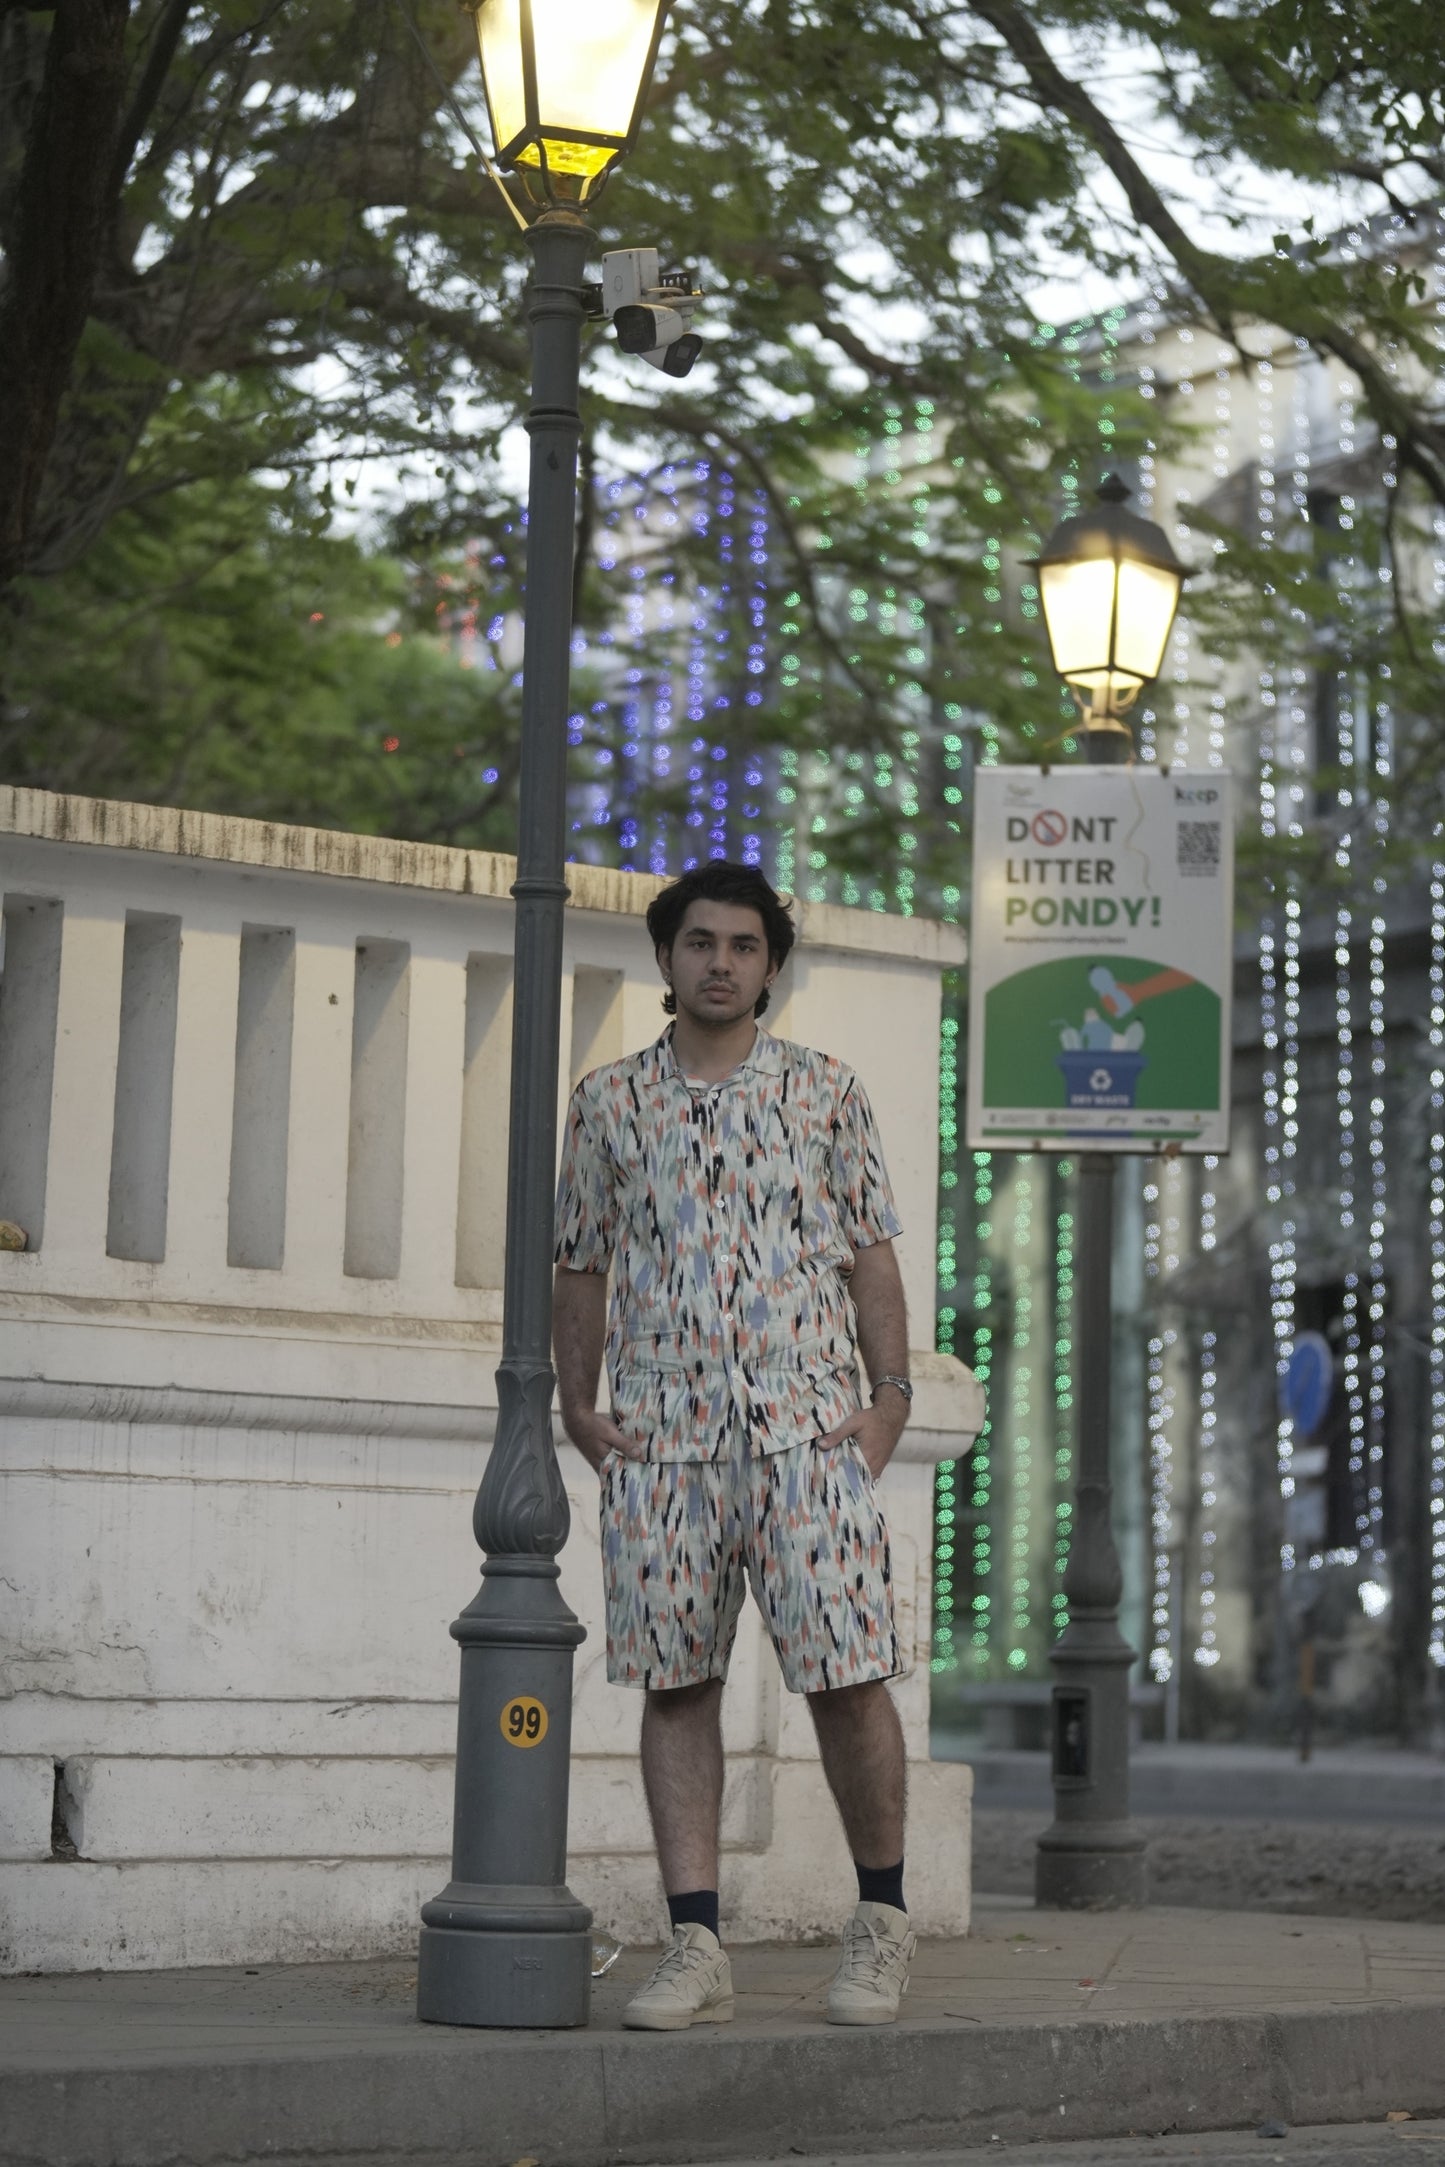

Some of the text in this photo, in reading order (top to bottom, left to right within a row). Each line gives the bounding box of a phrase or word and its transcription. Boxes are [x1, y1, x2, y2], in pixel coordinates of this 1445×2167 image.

[1006, 859, 1115, 884] LITTER
[1005, 896, 1162, 928] PONDY!
[509, 1704, 541, 1739] 99
